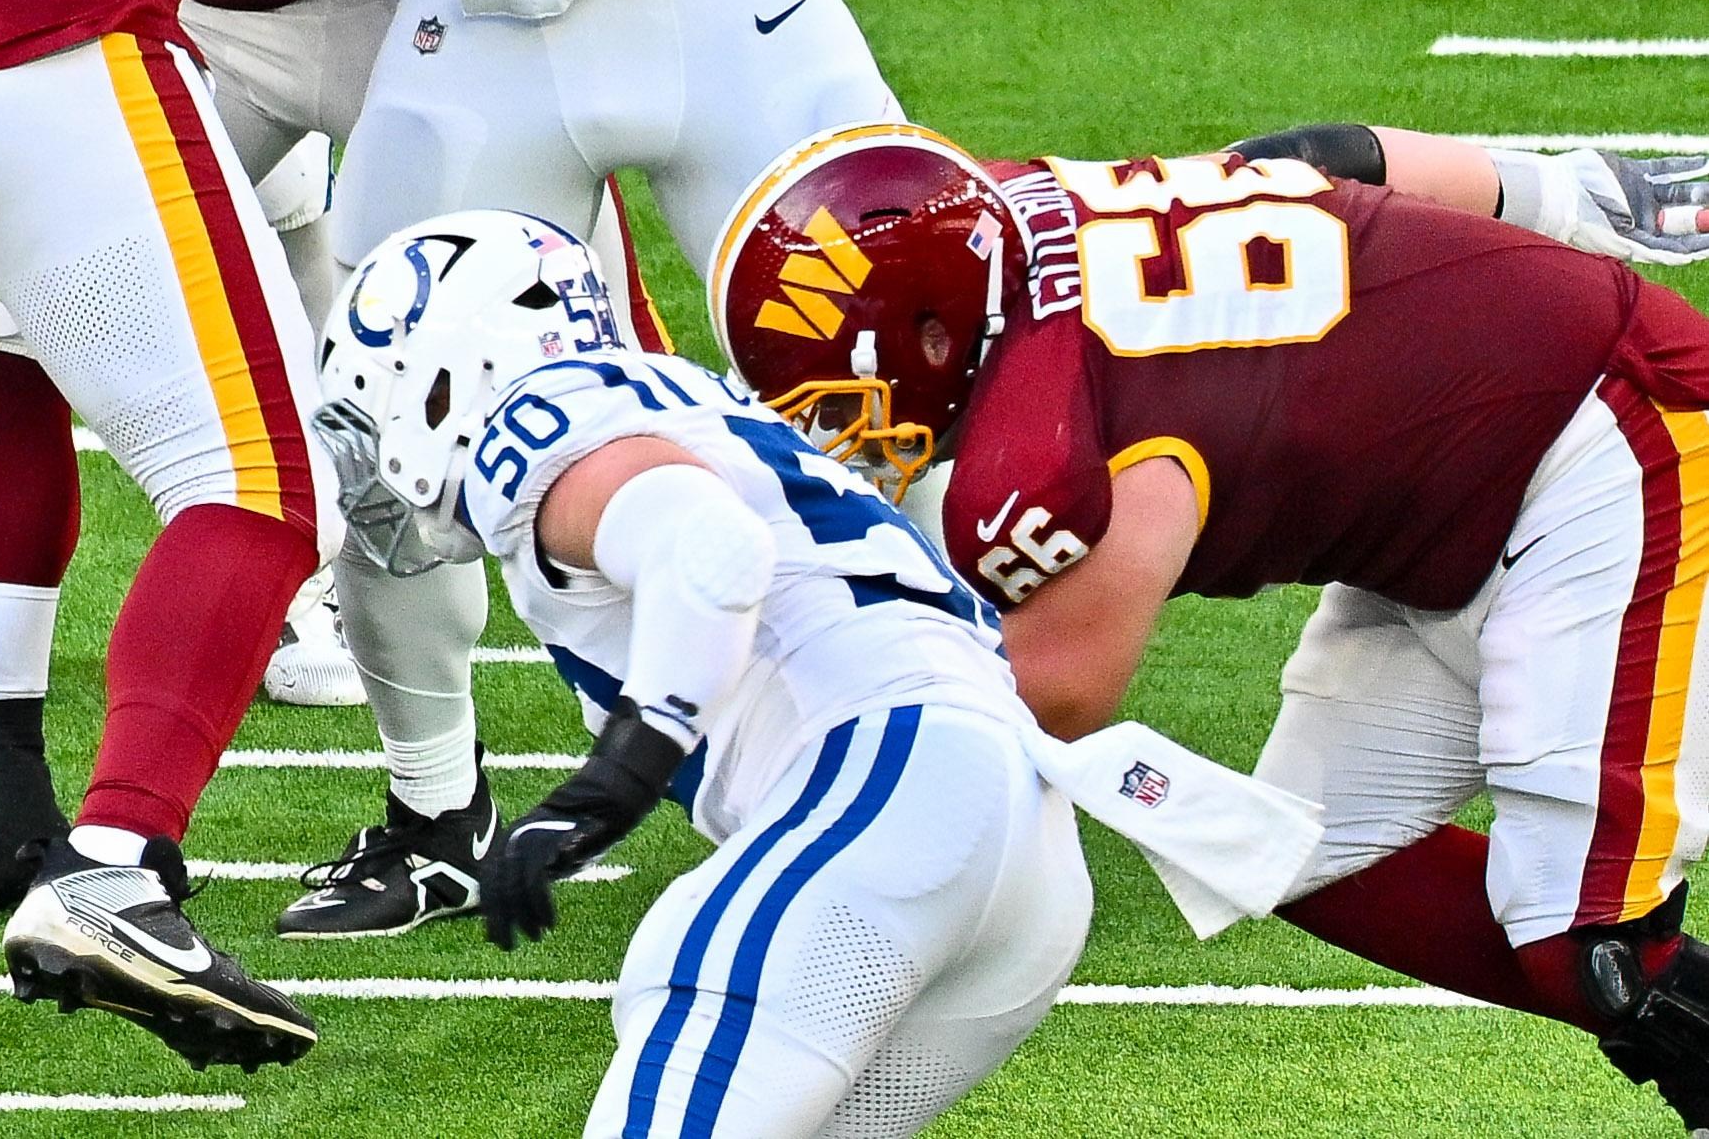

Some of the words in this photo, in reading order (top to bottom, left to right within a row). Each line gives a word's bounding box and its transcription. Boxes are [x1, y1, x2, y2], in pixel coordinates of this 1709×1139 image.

[475, 393, 571, 502] 50
[978, 506, 1091, 605] 66
[66, 916, 137, 963] FORCE
